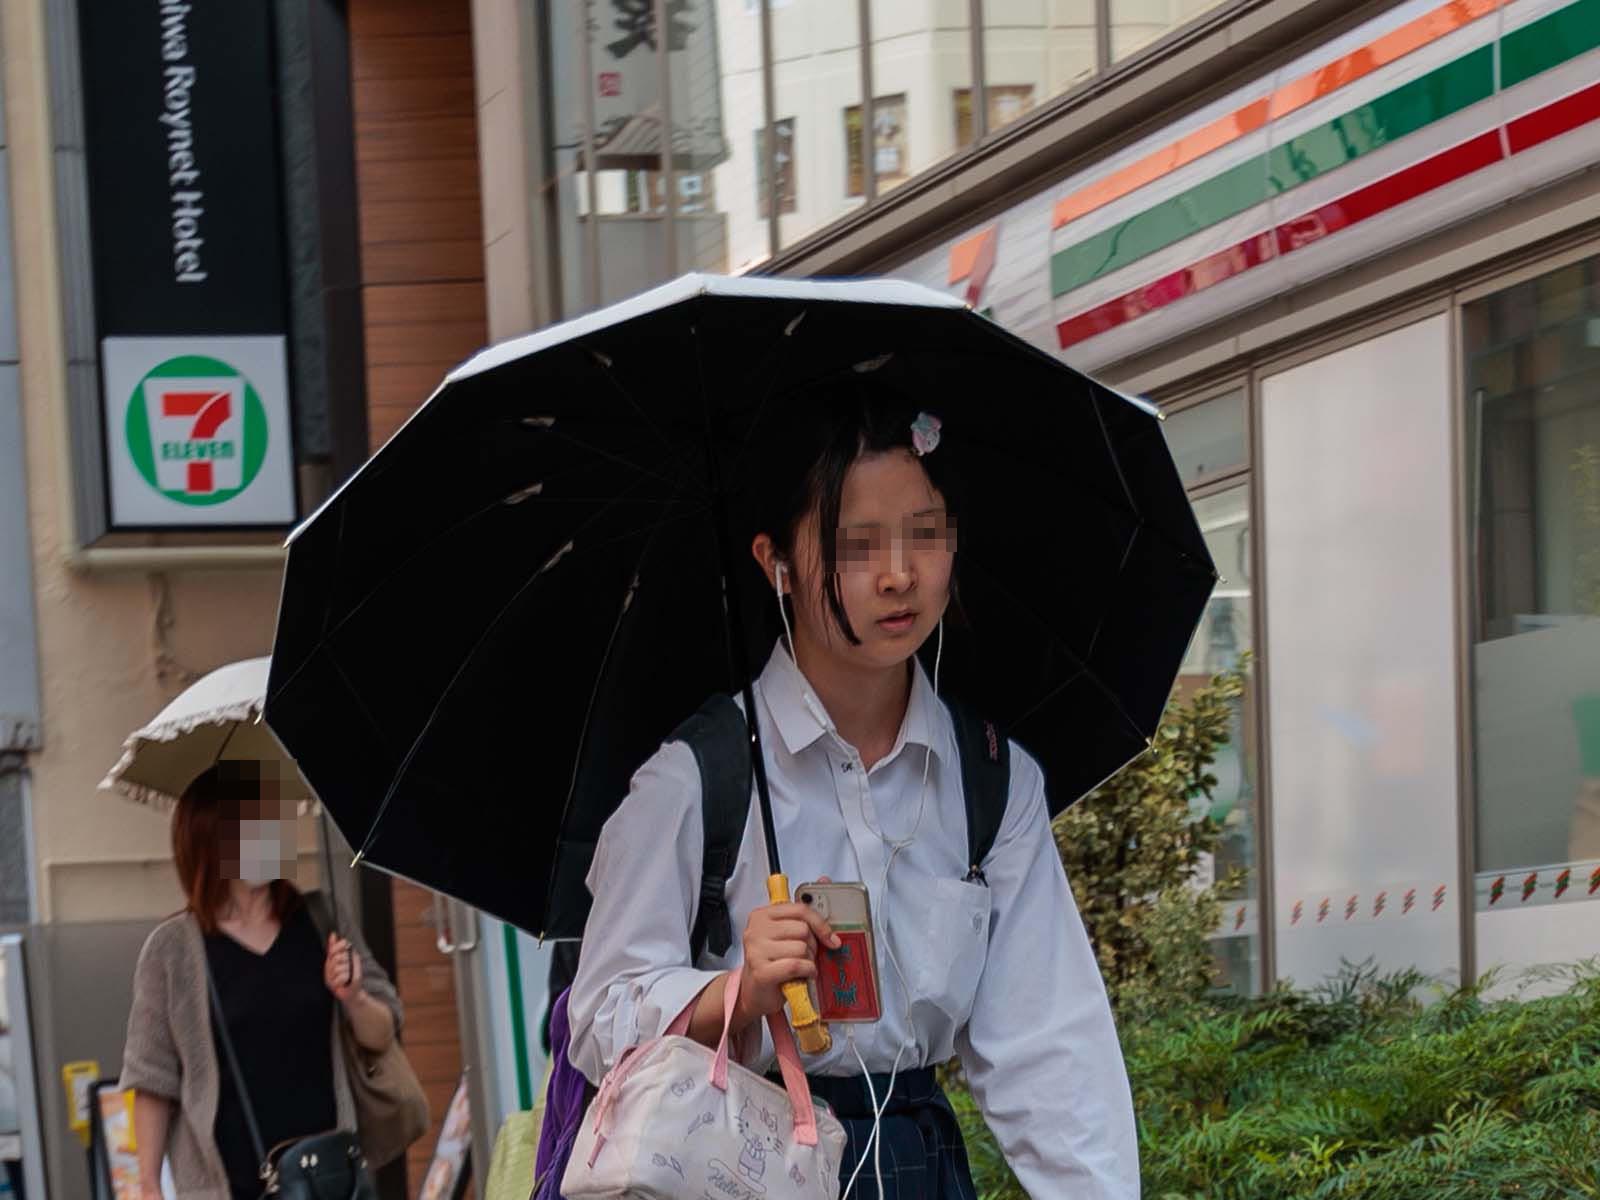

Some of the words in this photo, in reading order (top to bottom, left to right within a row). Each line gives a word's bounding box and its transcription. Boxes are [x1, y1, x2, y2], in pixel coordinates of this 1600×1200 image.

[159, 0, 192, 60] iwa
[158, 66, 200, 187] Roynet
[171, 191, 208, 282] Hotel
[162, 391, 232, 494] 7
